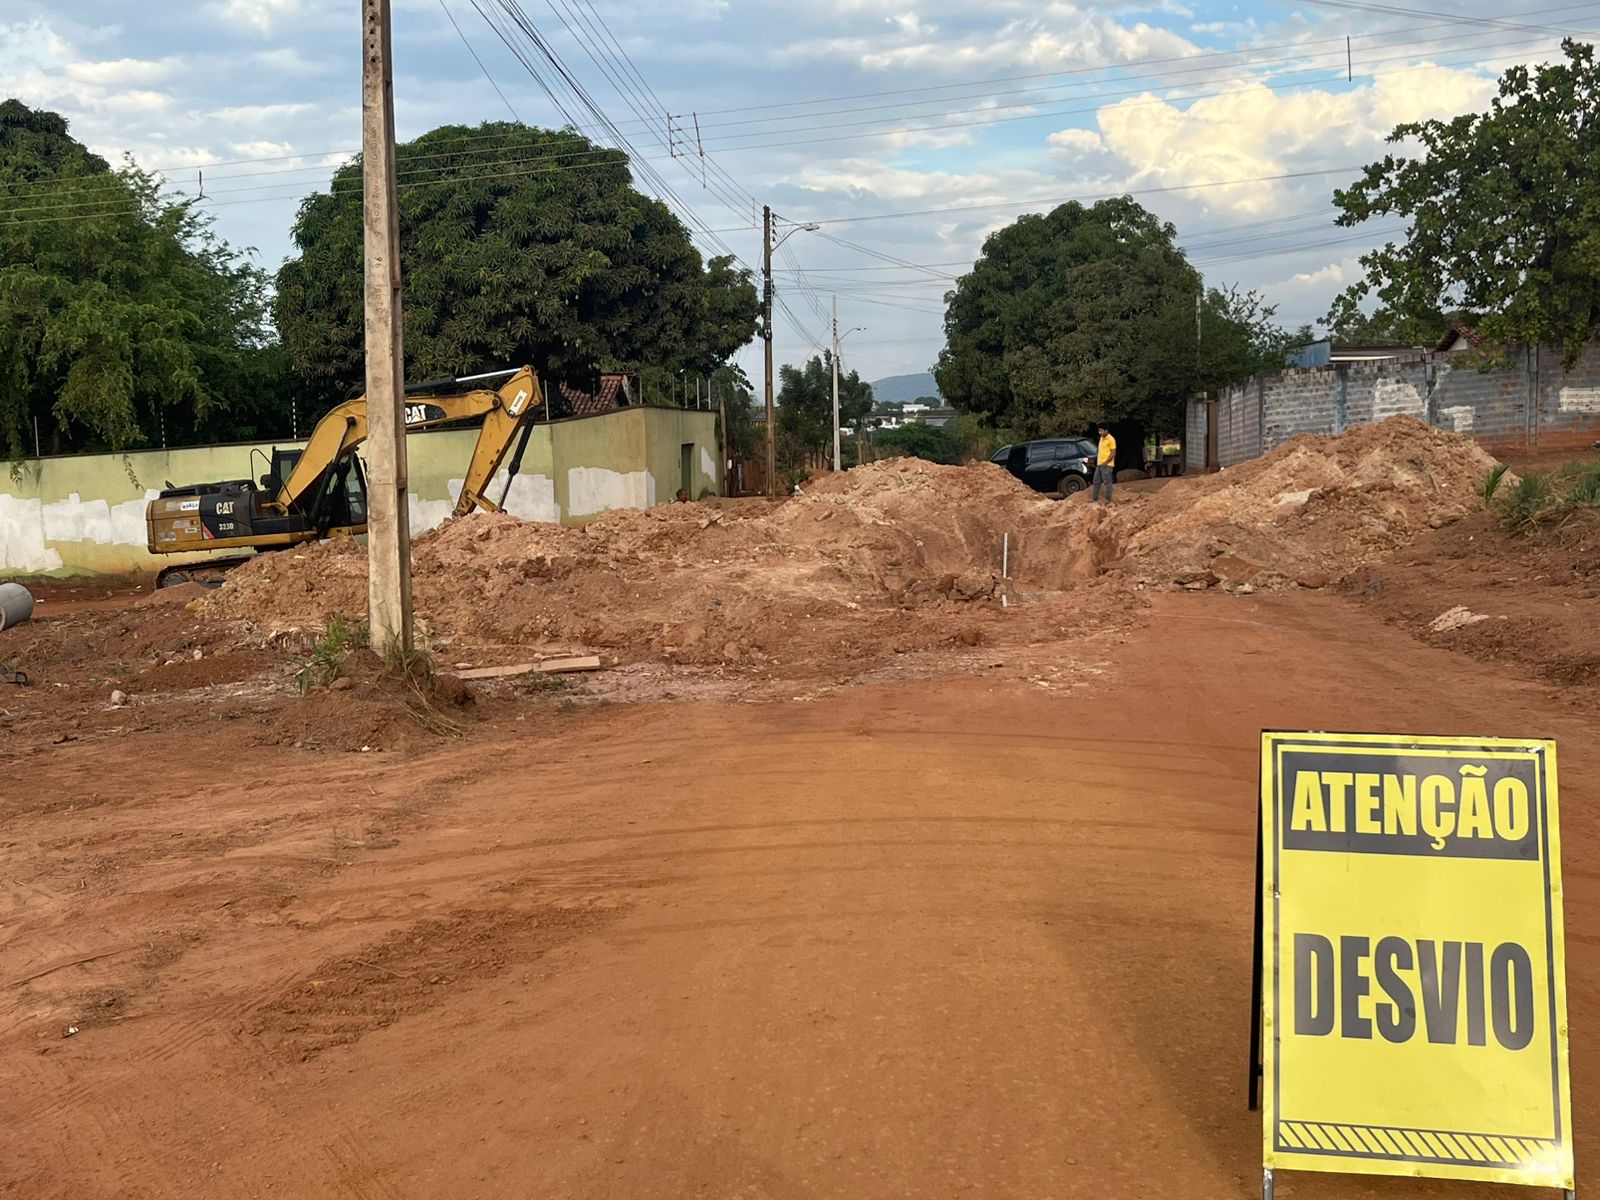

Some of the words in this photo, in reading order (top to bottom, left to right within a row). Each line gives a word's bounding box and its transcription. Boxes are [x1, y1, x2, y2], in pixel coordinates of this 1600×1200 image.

[405, 404, 426, 424] CAT
[216, 501, 234, 515] CAT
[1290, 764, 1530, 850] ATENÇÃO
[1293, 932, 1534, 1051] DESVIO
